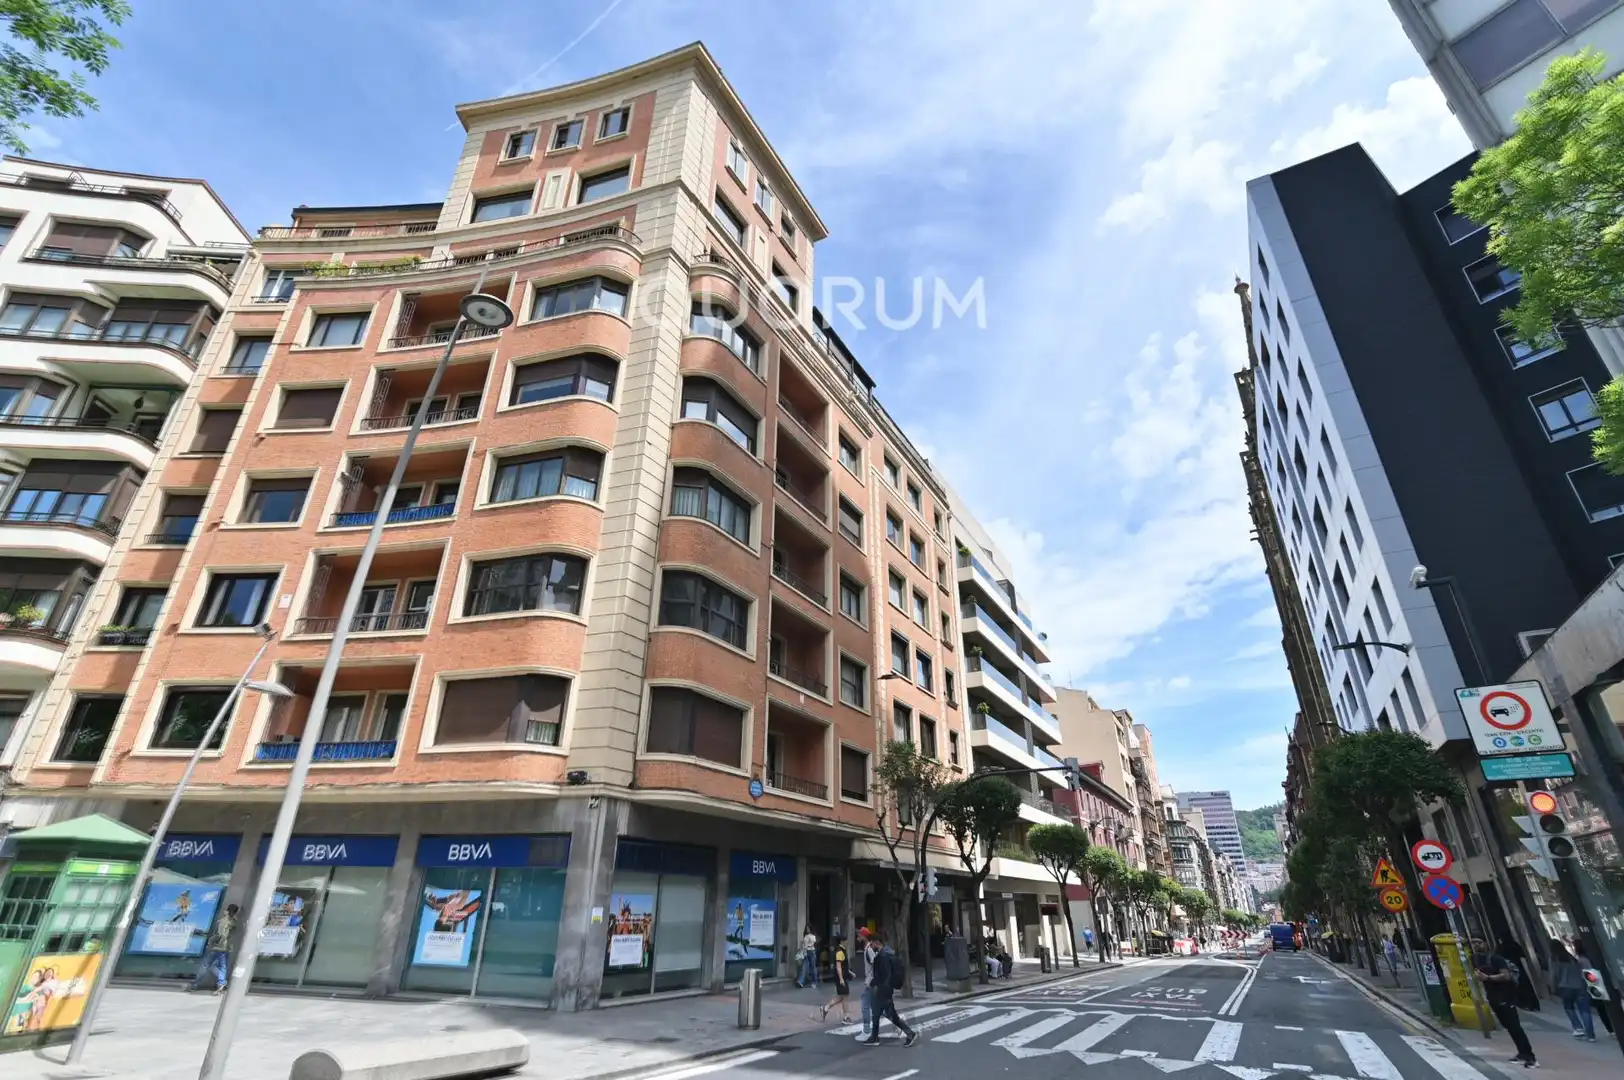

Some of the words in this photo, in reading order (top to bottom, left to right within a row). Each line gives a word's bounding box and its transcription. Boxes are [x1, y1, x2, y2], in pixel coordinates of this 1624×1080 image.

[165, 839, 214, 858] BBVA
[302, 843, 347, 862] BBVA
[448, 842, 492, 860] BBVA
[752, 860, 776, 874] BBVA
[1386, 895, 1402, 905] 20
[1130, 991, 1196, 1000] TAXI
